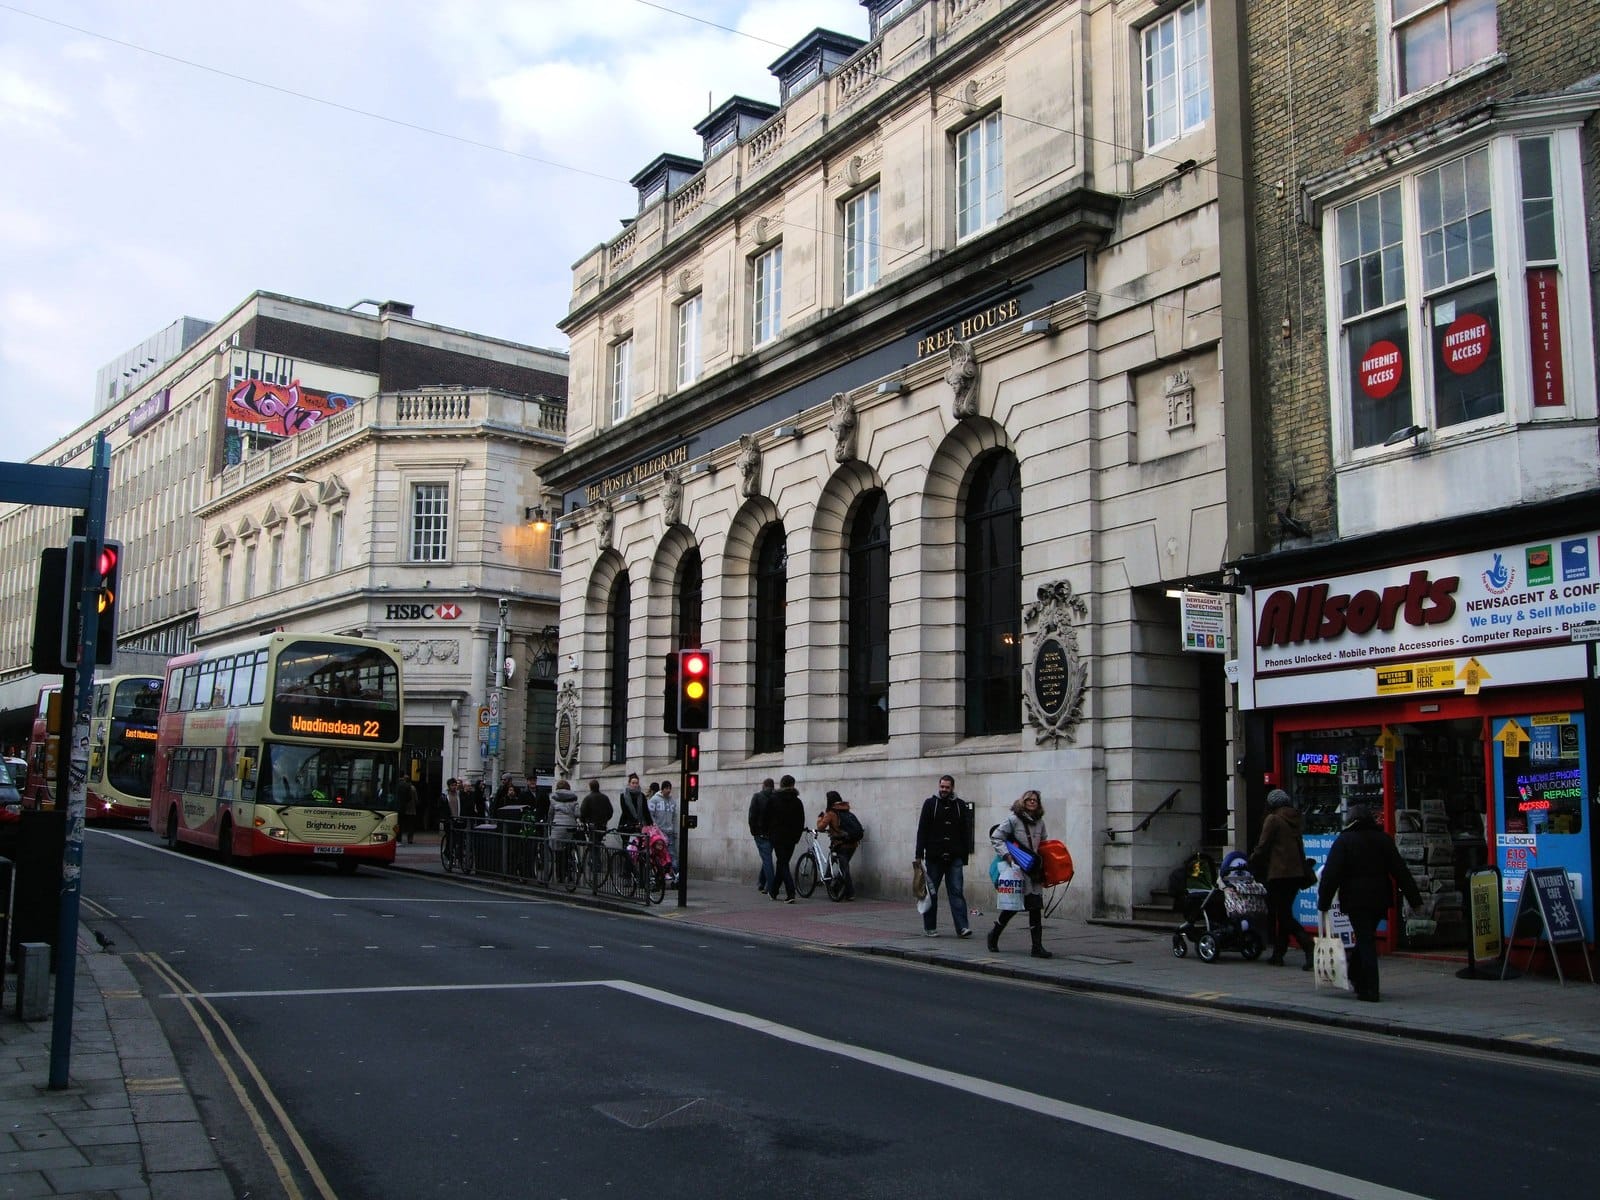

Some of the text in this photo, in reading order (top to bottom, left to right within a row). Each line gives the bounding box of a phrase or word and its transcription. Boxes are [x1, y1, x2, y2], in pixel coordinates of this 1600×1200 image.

[917, 299, 1018, 358] FREE HOUSE
[1446, 324, 1486, 347] INTERNET
[1539, 272, 1553, 400] INTERNET CAFE
[1452, 342, 1482, 362] ACCESS
[1362, 351, 1398, 373] INTERNET
[1367, 368, 1394, 386] ACCESS
[585, 445, 687, 503] THE POST & TELEGRAPH
[1466, 591, 1544, 612] NEWSAGENT
[1549, 589, 1559, 601] &
[386, 604, 435, 620] HSBC
[1256, 570, 1460, 649] Allsorts
[1470, 601, 1597, 627] We Buy & Sell Mobile
[1264, 659, 1293, 668] Phones
[1294, 651, 1332, 664] Unlocked
[1339, 648, 1367, 659] Mobile
[1369, 645, 1396, 656] Phone
[1398, 638, 1455, 651] Accessories
[1462, 630, 1509, 644] Computer
[1512, 625, 1552, 638] Repairs
[1416, 675, 1434, 688] HERE
[292, 715, 380, 737] Woodingdean 22
[1296, 753, 1338, 764] LAPTOP & PC
[1308, 764, 1331, 773] REPAIRS
[1517, 769, 1581, 784] ALL MOBILE PHONE
[1534, 779, 1581, 791] UNLOCKING
[1543, 788, 1581, 800] REPAIRS
[306, 821, 336, 831] Brighton
[1505, 836, 1535, 845] Lebara
[1507, 848, 1527, 859] £10
[1506, 861, 1527, 869] FREE
[1537, 875, 1565, 888] INTERNET
[1546, 888, 1562, 899] CAFE
